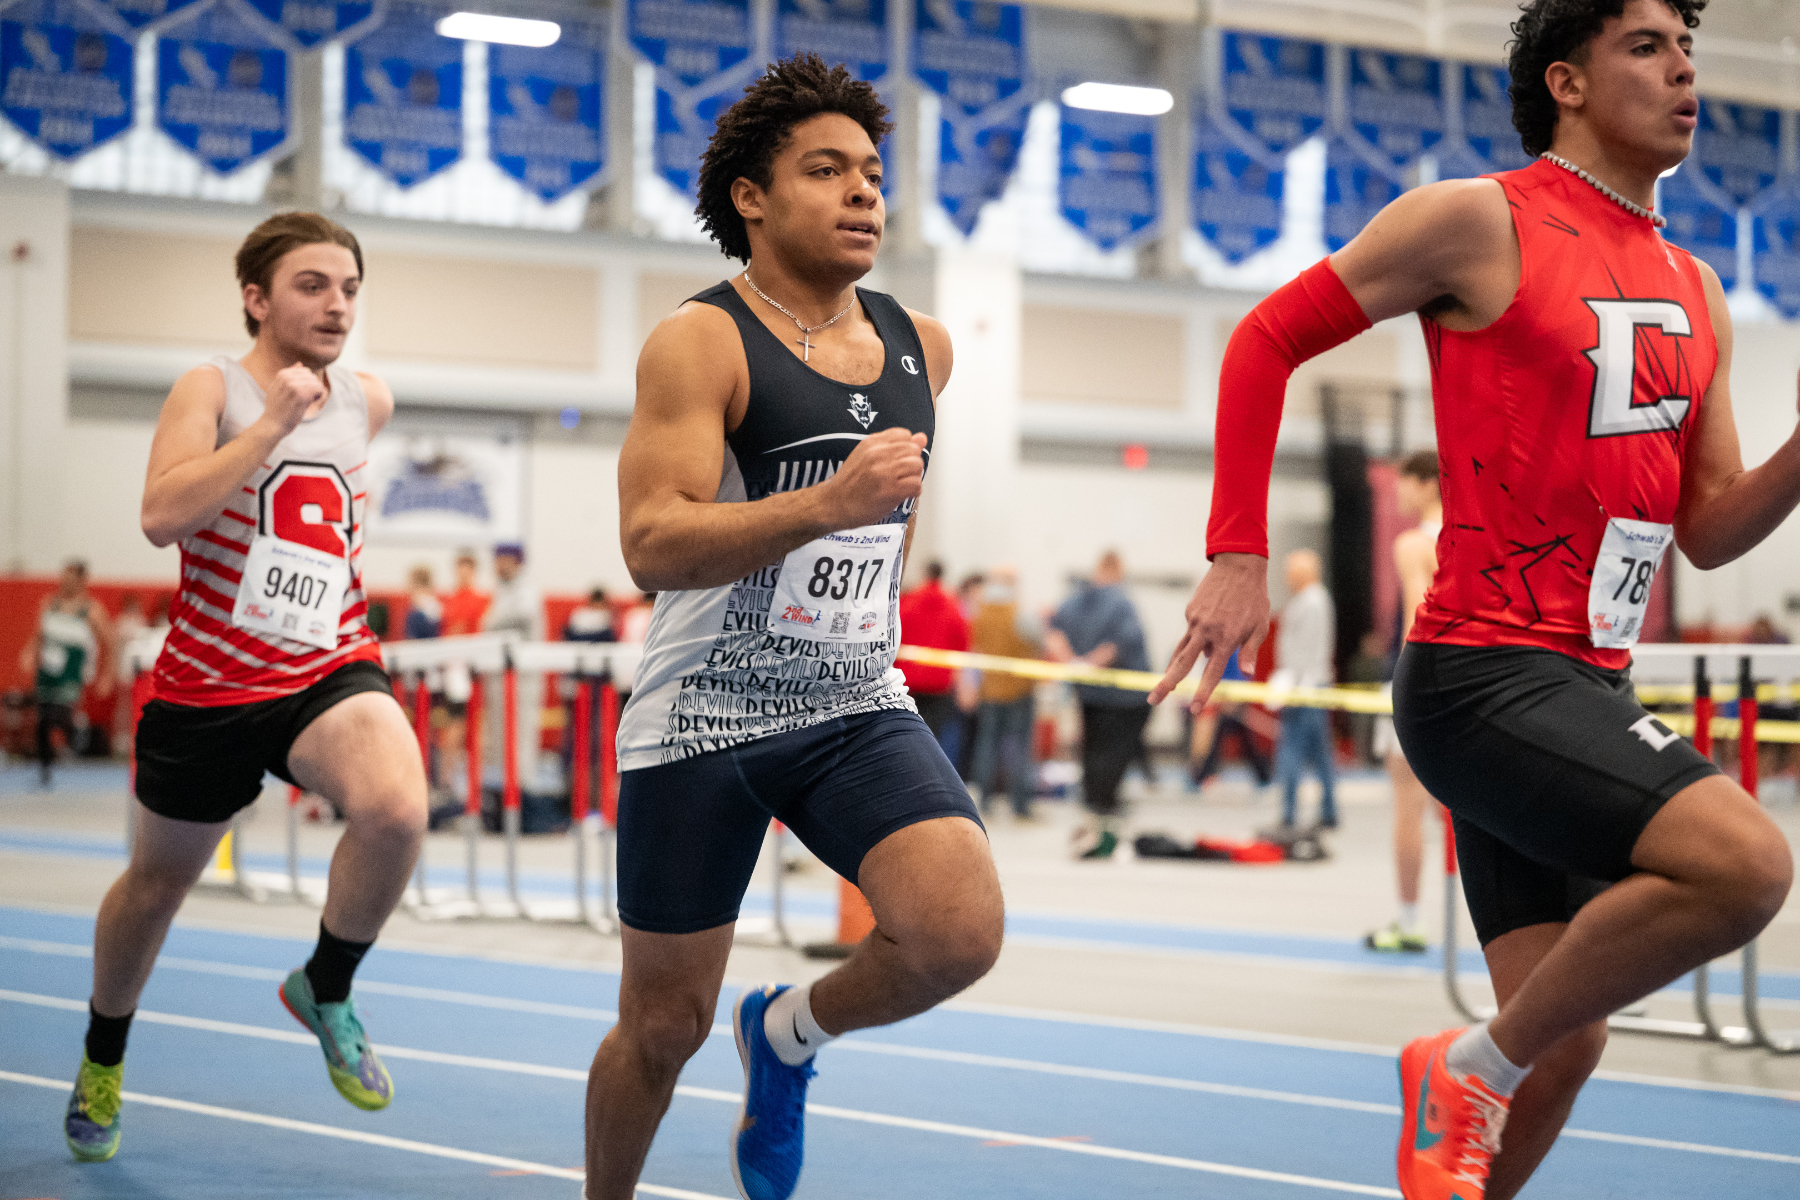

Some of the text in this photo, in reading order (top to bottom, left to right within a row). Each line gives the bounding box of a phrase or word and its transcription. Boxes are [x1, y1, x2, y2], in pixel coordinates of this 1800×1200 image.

[1580, 297, 1693, 439] C
[820, 532, 892, 544] chwab's 2nd Wind
[264, 567, 328, 610] 9407
[808, 556, 884, 600] 8317
[790, 612, 814, 624] WIND
[760, 635, 820, 658] DEVILS
[754, 652, 821, 680] DEVILS
[817, 657, 869, 681] DEVILS
[678, 691, 744, 715] DEVILS
[678, 714, 742, 734] DEVILS
